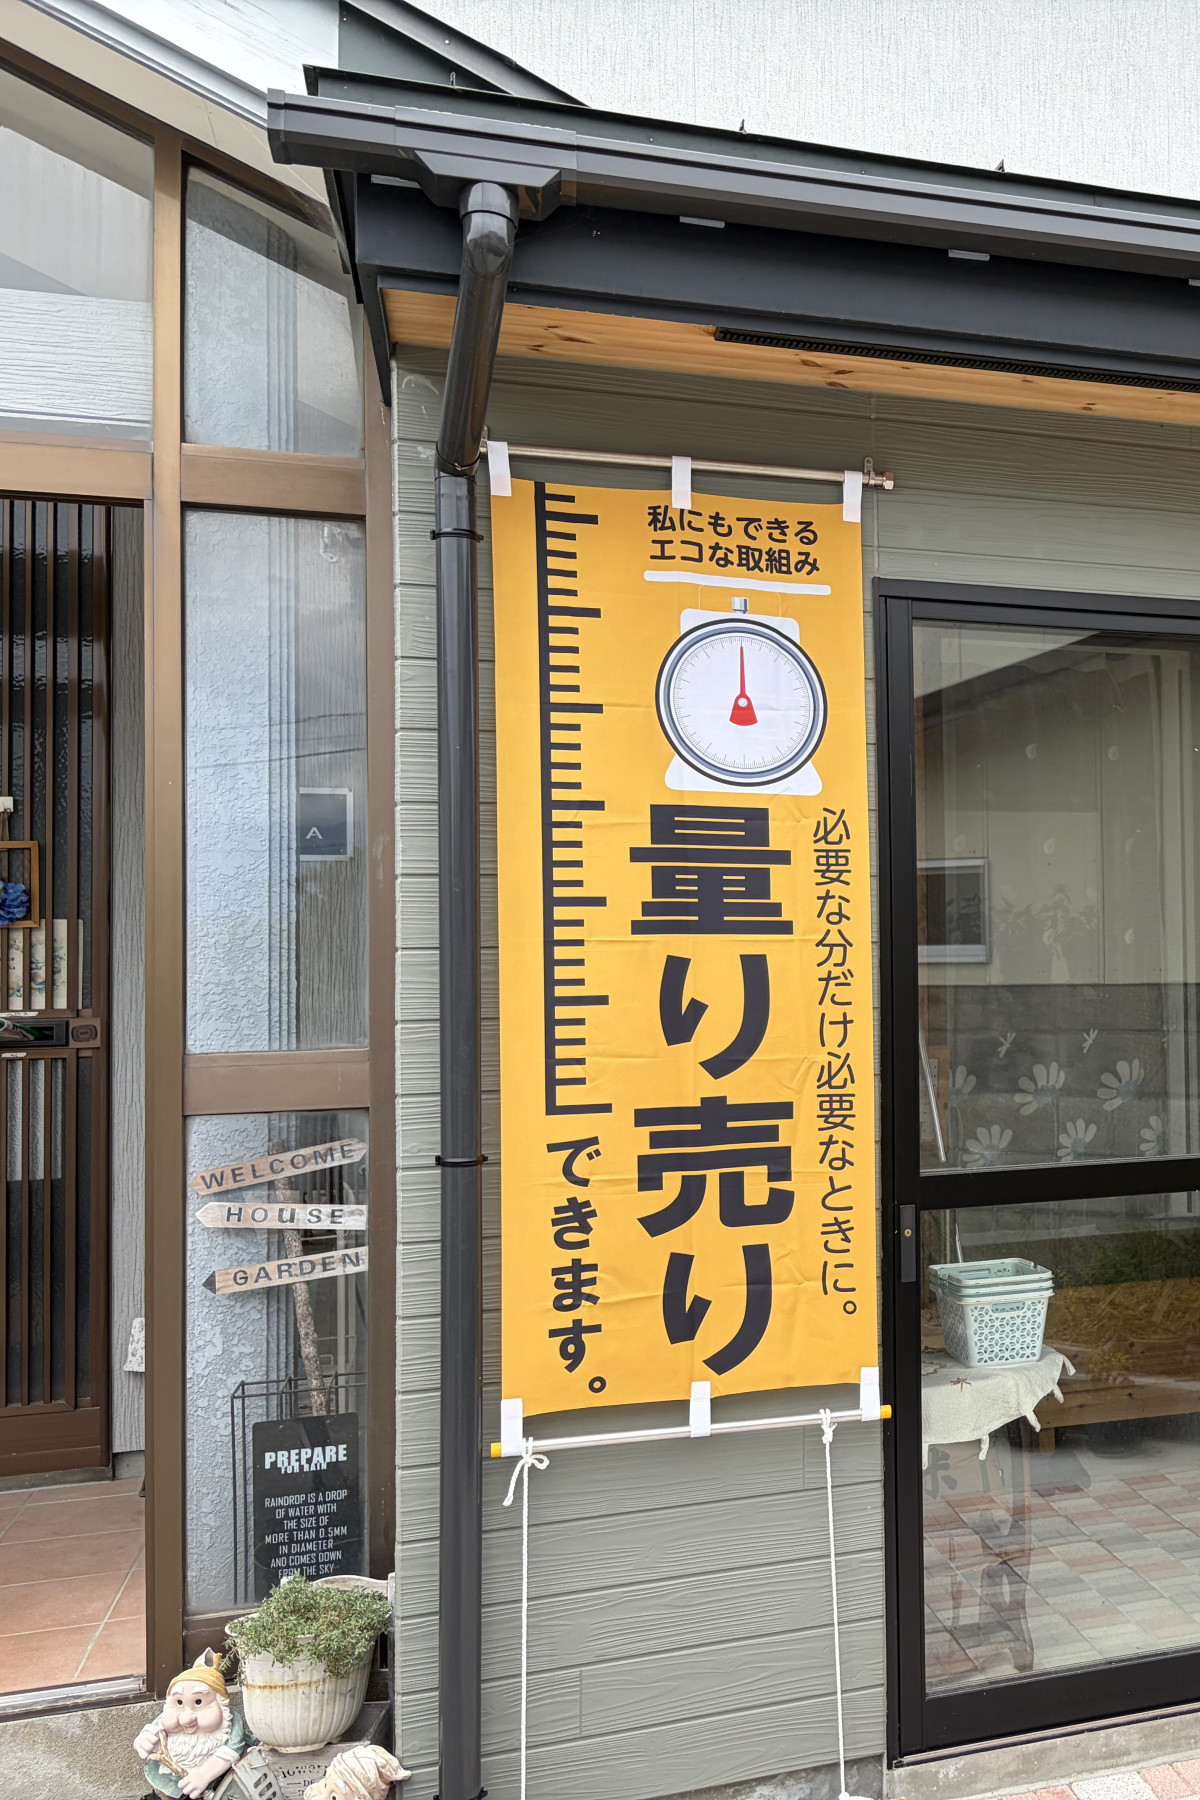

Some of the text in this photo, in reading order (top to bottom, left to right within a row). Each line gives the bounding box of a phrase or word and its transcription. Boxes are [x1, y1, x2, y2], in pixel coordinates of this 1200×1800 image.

[647, 504, 818, 546] 私にもできる
[649, 539, 820, 576] エコな取組み
[812, 806, 857, 1316] 必要な分だけ必要なときに。
[629, 803, 796, 1377] 量り売り
[200, 1143, 355, 1190] WELCOME
[225, 1206, 344, 1225] HOUSE
[232, 1251, 361, 1287] GARDEN
[545, 1134, 607, 1395] できます。
[264, 1444, 348, 1470] PREPARE
[281, 1461, 327, 1475] FOR RAIN
[264, 1489, 348, 1508] RAINDROP IS A DROP
[275, 1502, 337, 1519] OF WATER WITH
[283, 1515, 330, 1530] THE SIZE OF
[265, 1525, 348, 1544] MORE THAN 0.5MM
[279, 1539, 334, 1555] IN DIAMETER
[270, 1550, 342, 1568] AND COMES DOWN
[302, 1565, 317, 1577] THE
[319, 1563, 335, 1575] SKY
